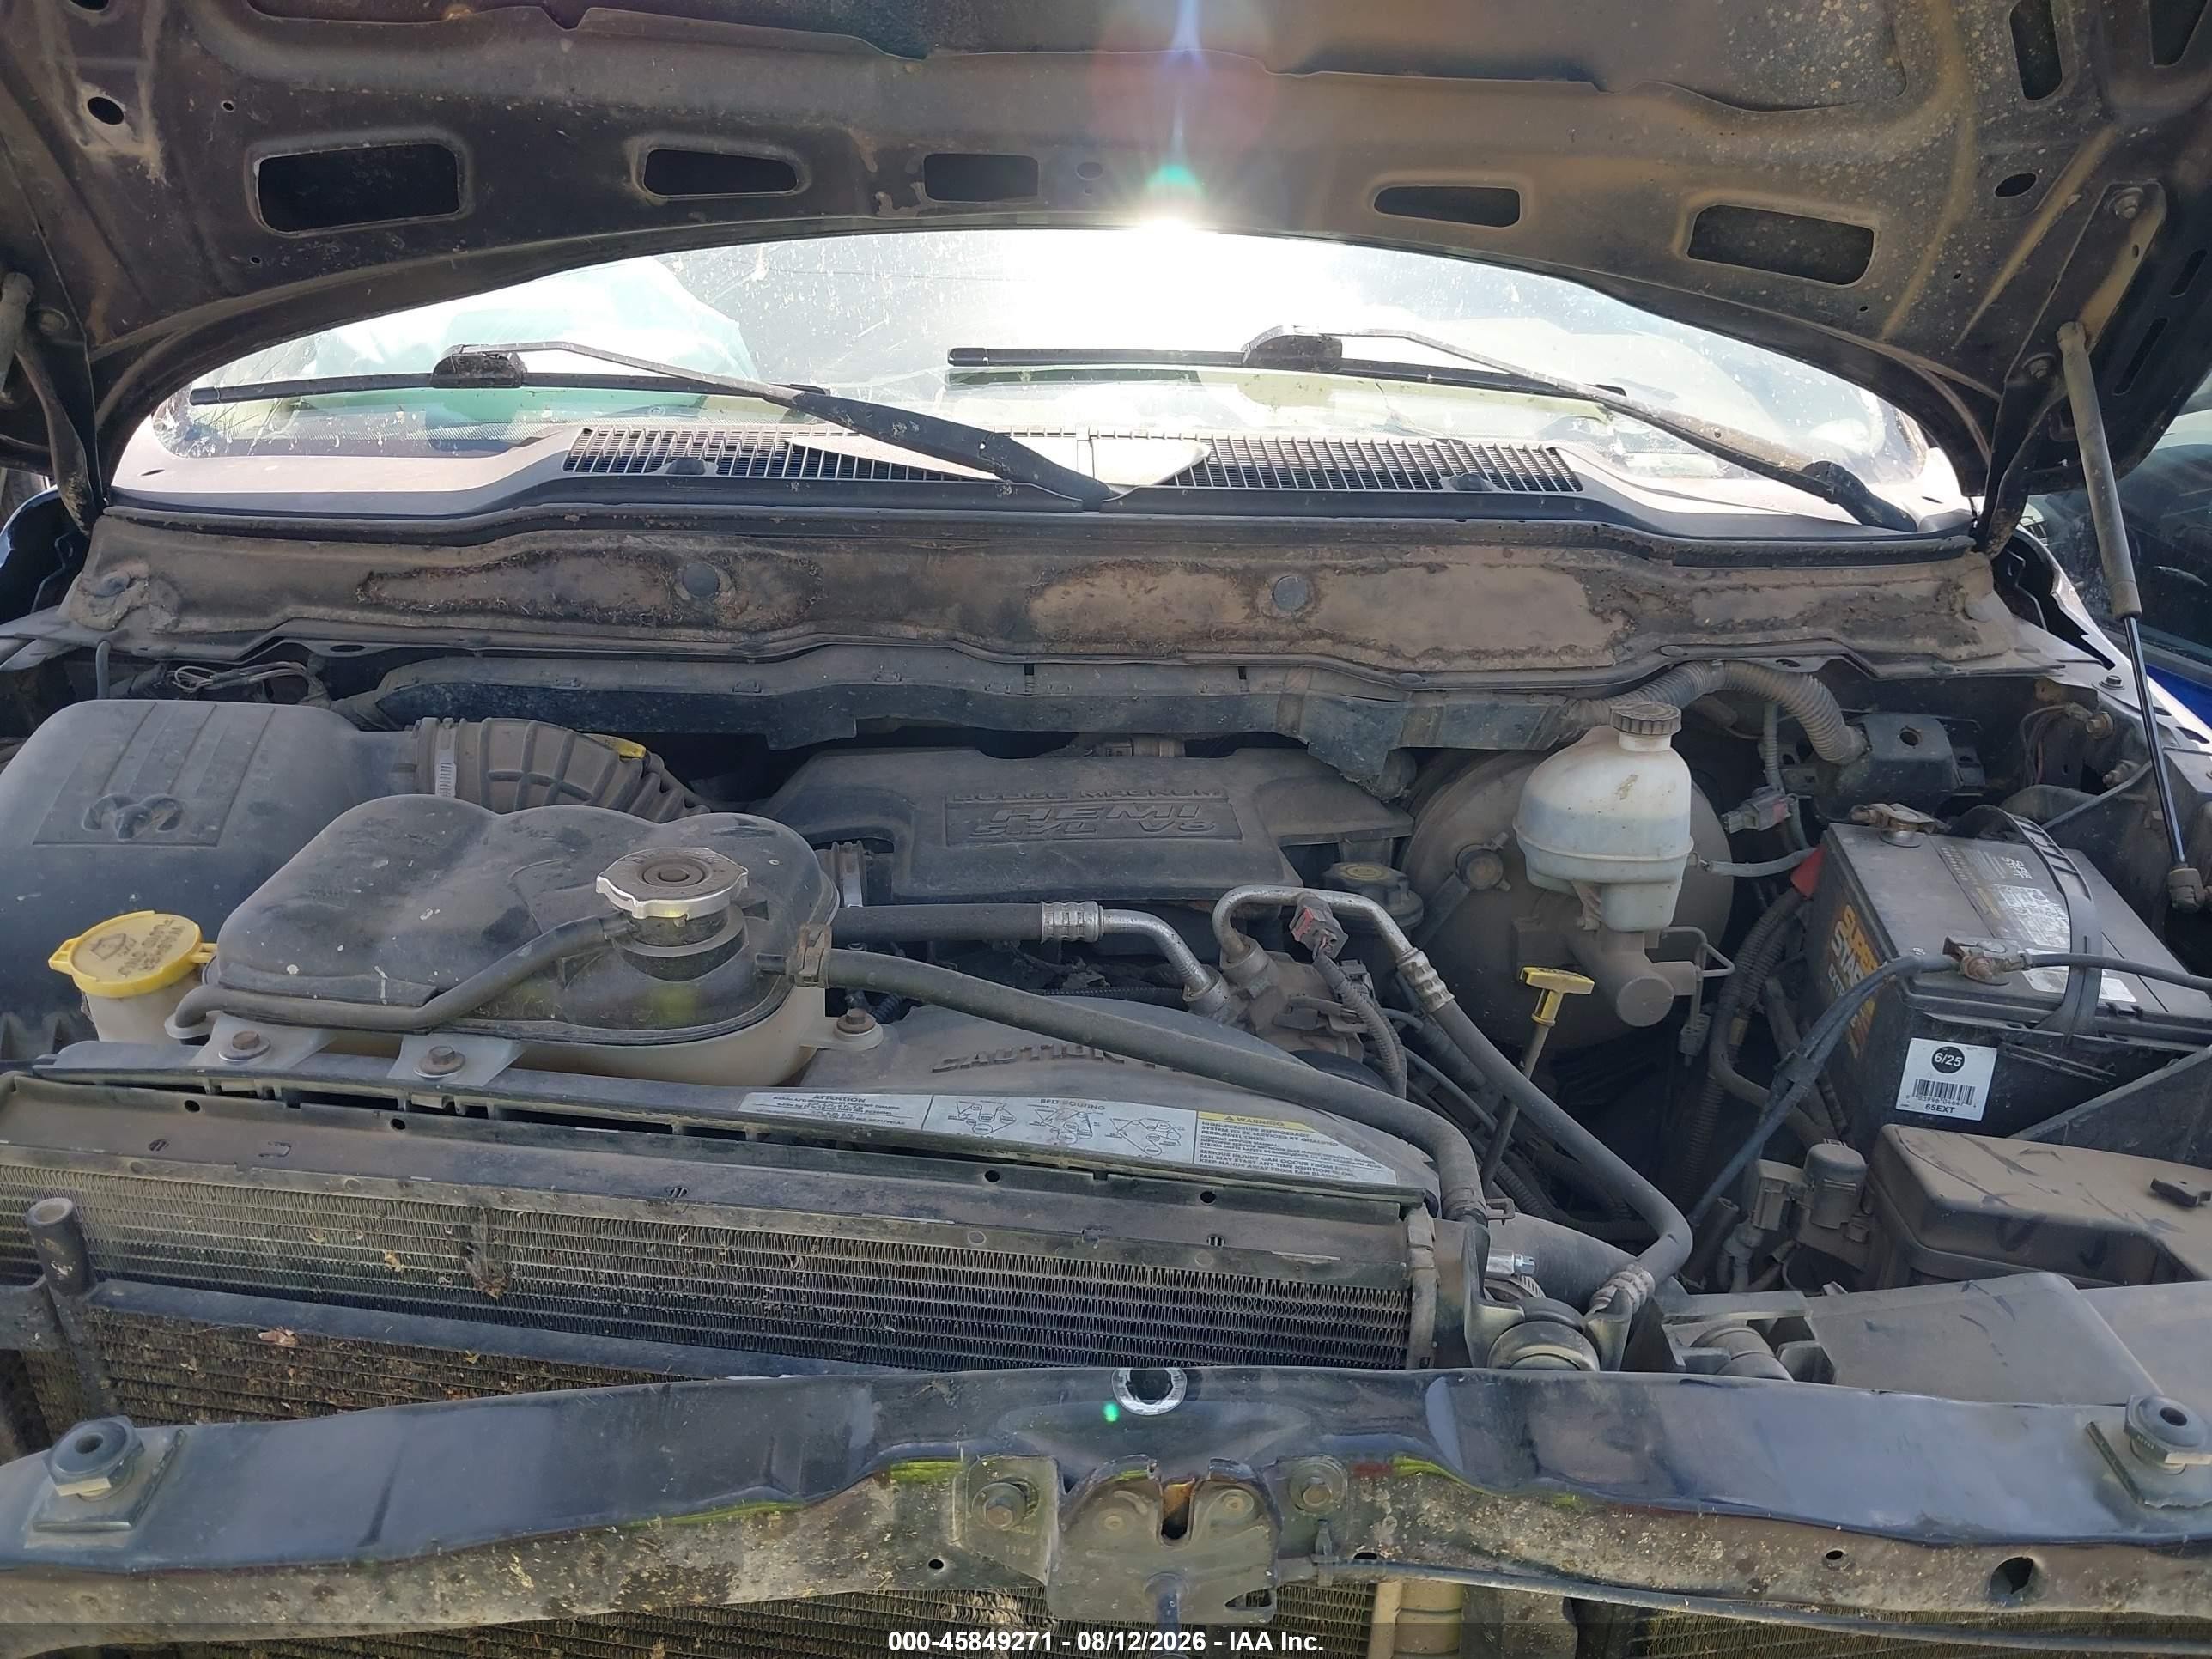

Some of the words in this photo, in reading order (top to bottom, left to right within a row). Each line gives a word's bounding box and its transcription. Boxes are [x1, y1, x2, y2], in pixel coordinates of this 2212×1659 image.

[990, 804, 1203, 823] HEMI
[1139, 820, 1216, 833] V8
[1934, 1052, 1963, 1066] 6/25
[813, 1094, 866, 1103] ATTENTION
[1061, 1099, 1106, 1110] ROUTING
[1925, 1103, 1956, 1114] 65EXT
[1237, 1116, 1285, 1127] WARNING
[1201, 1130, 1242, 1139] PERSONNEL
